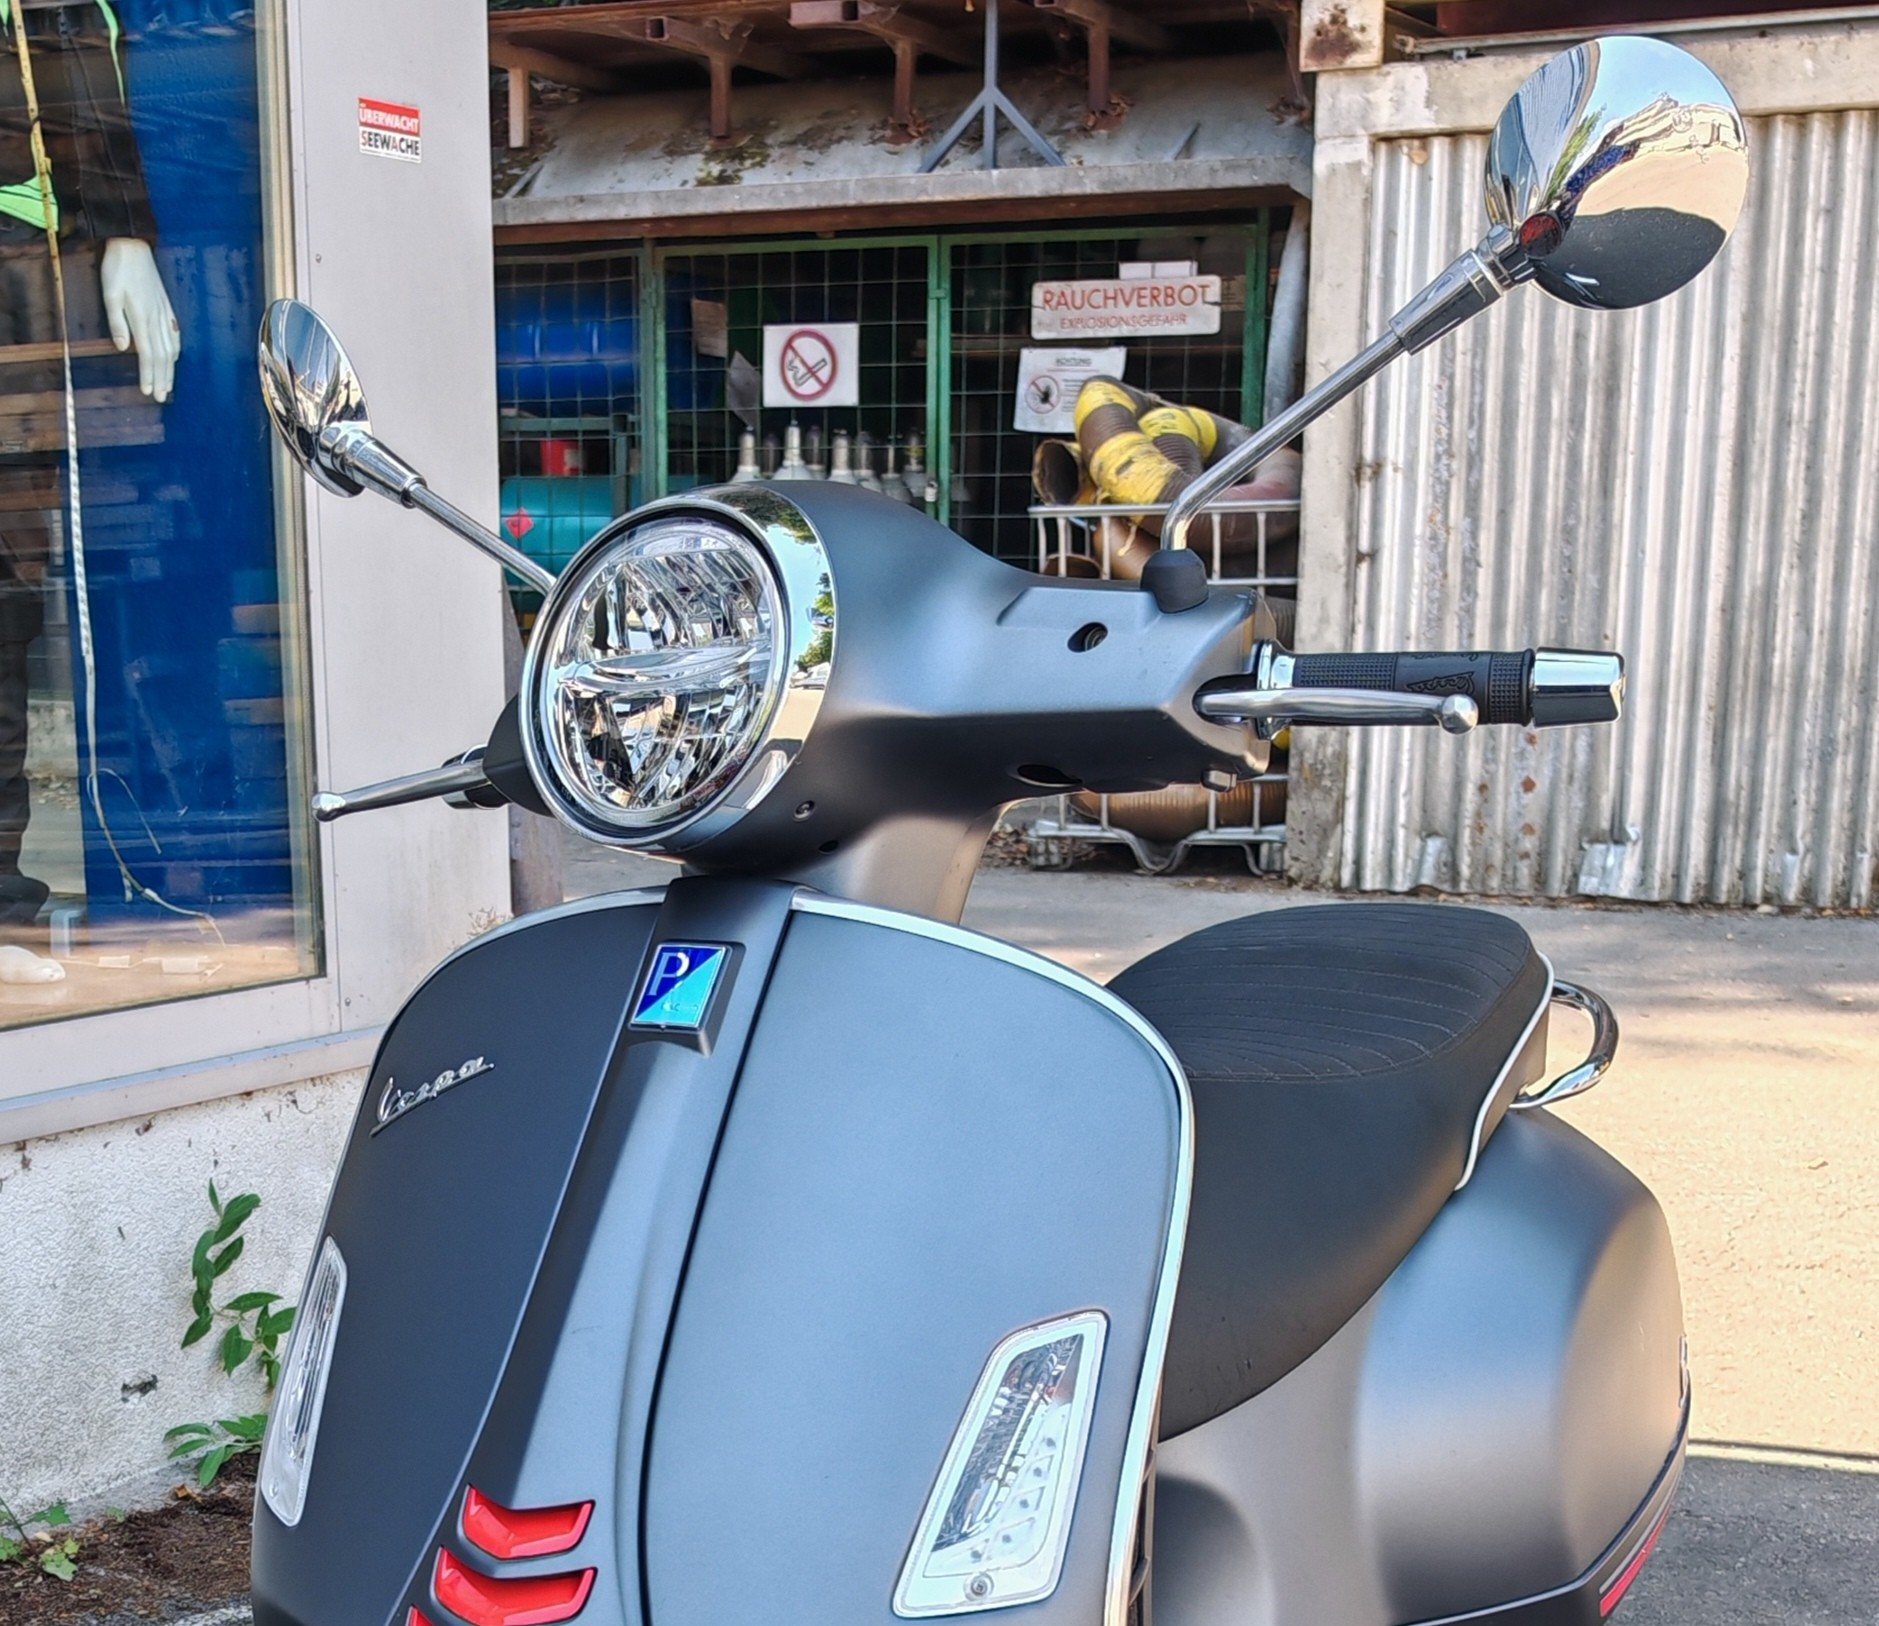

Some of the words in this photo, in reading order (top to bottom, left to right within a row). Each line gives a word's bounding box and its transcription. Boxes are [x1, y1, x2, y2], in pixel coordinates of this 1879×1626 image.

[361, 131, 420, 156] SEEWACHE
[1042, 284, 1211, 311] RAUCHVERBOT
[1060, 313, 1188, 330] EXPLOSIONSGEFAHR
[370, 1056, 495, 1136] Vespa
